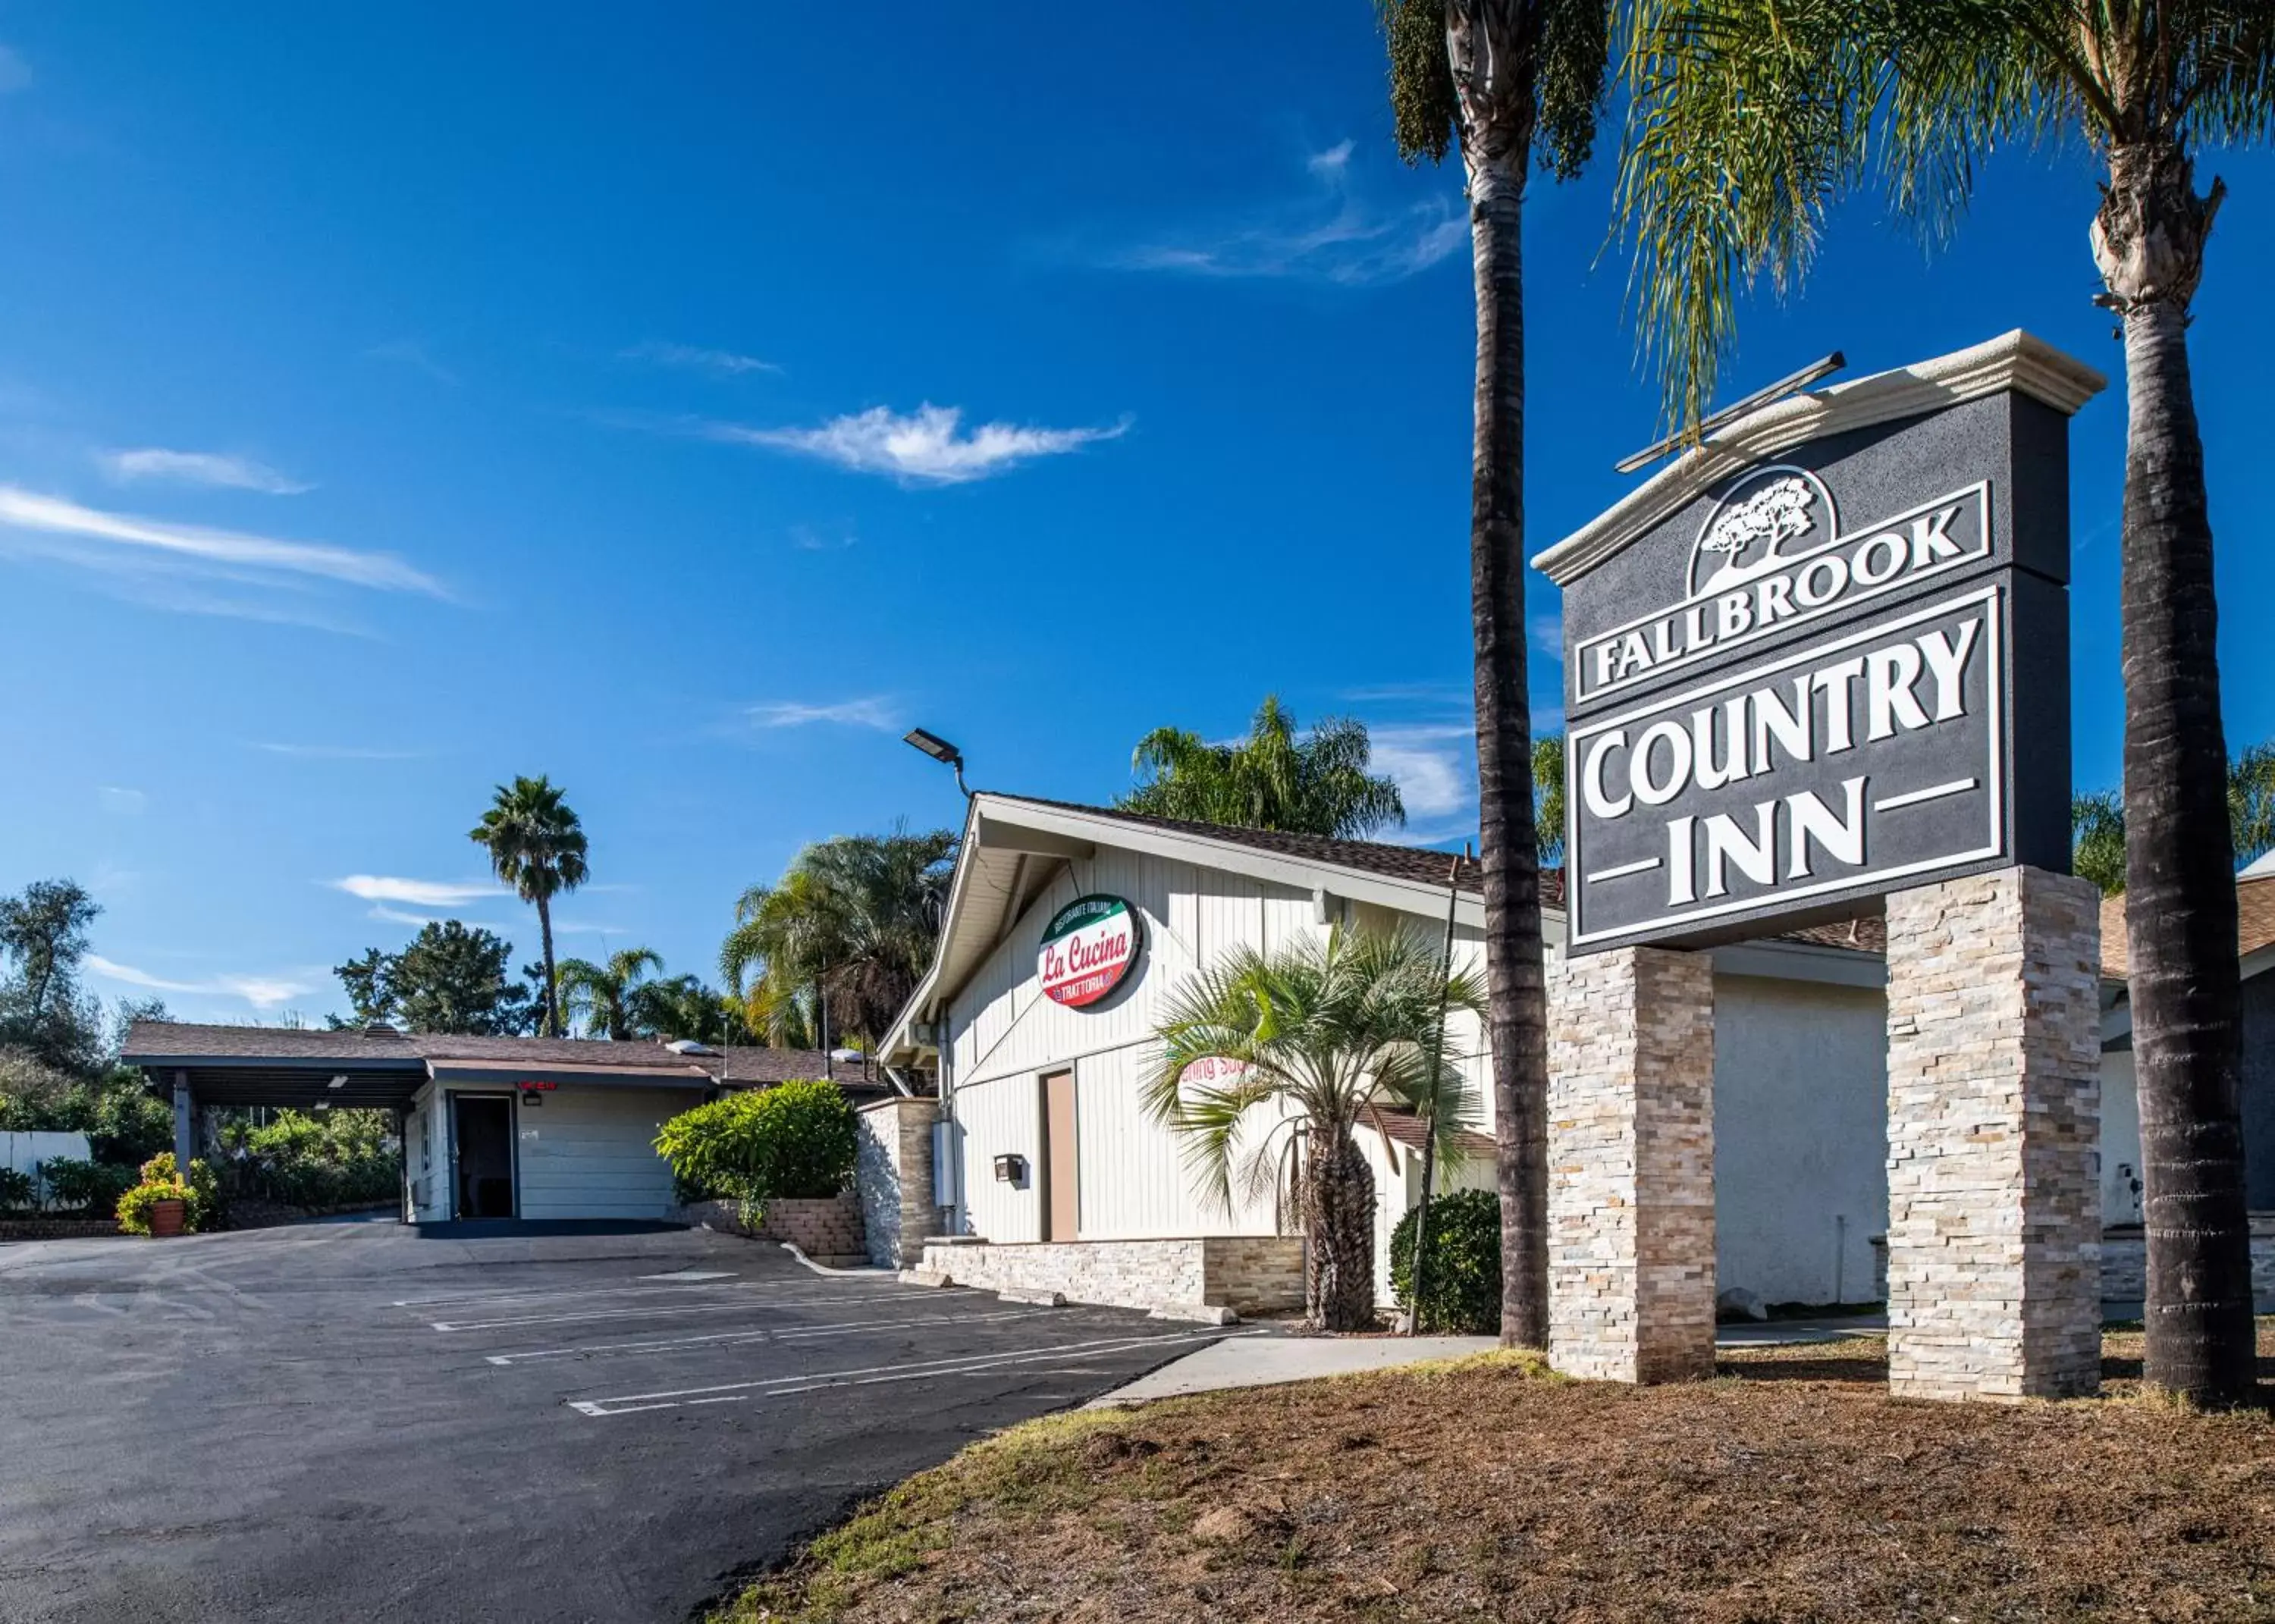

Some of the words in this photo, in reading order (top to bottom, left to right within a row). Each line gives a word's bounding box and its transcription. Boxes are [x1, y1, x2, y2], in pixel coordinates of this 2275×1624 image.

[1596, 506, 1961, 685] FALLBROOK
[1583, 618, 1980, 819] COUNTRY
[1667, 776, 1868, 906] INN
[1043, 945, 1065, 983] La
[1068, 930, 1128, 973] Cucina
[1062, 973, 1105, 1002] TRATTORIA
